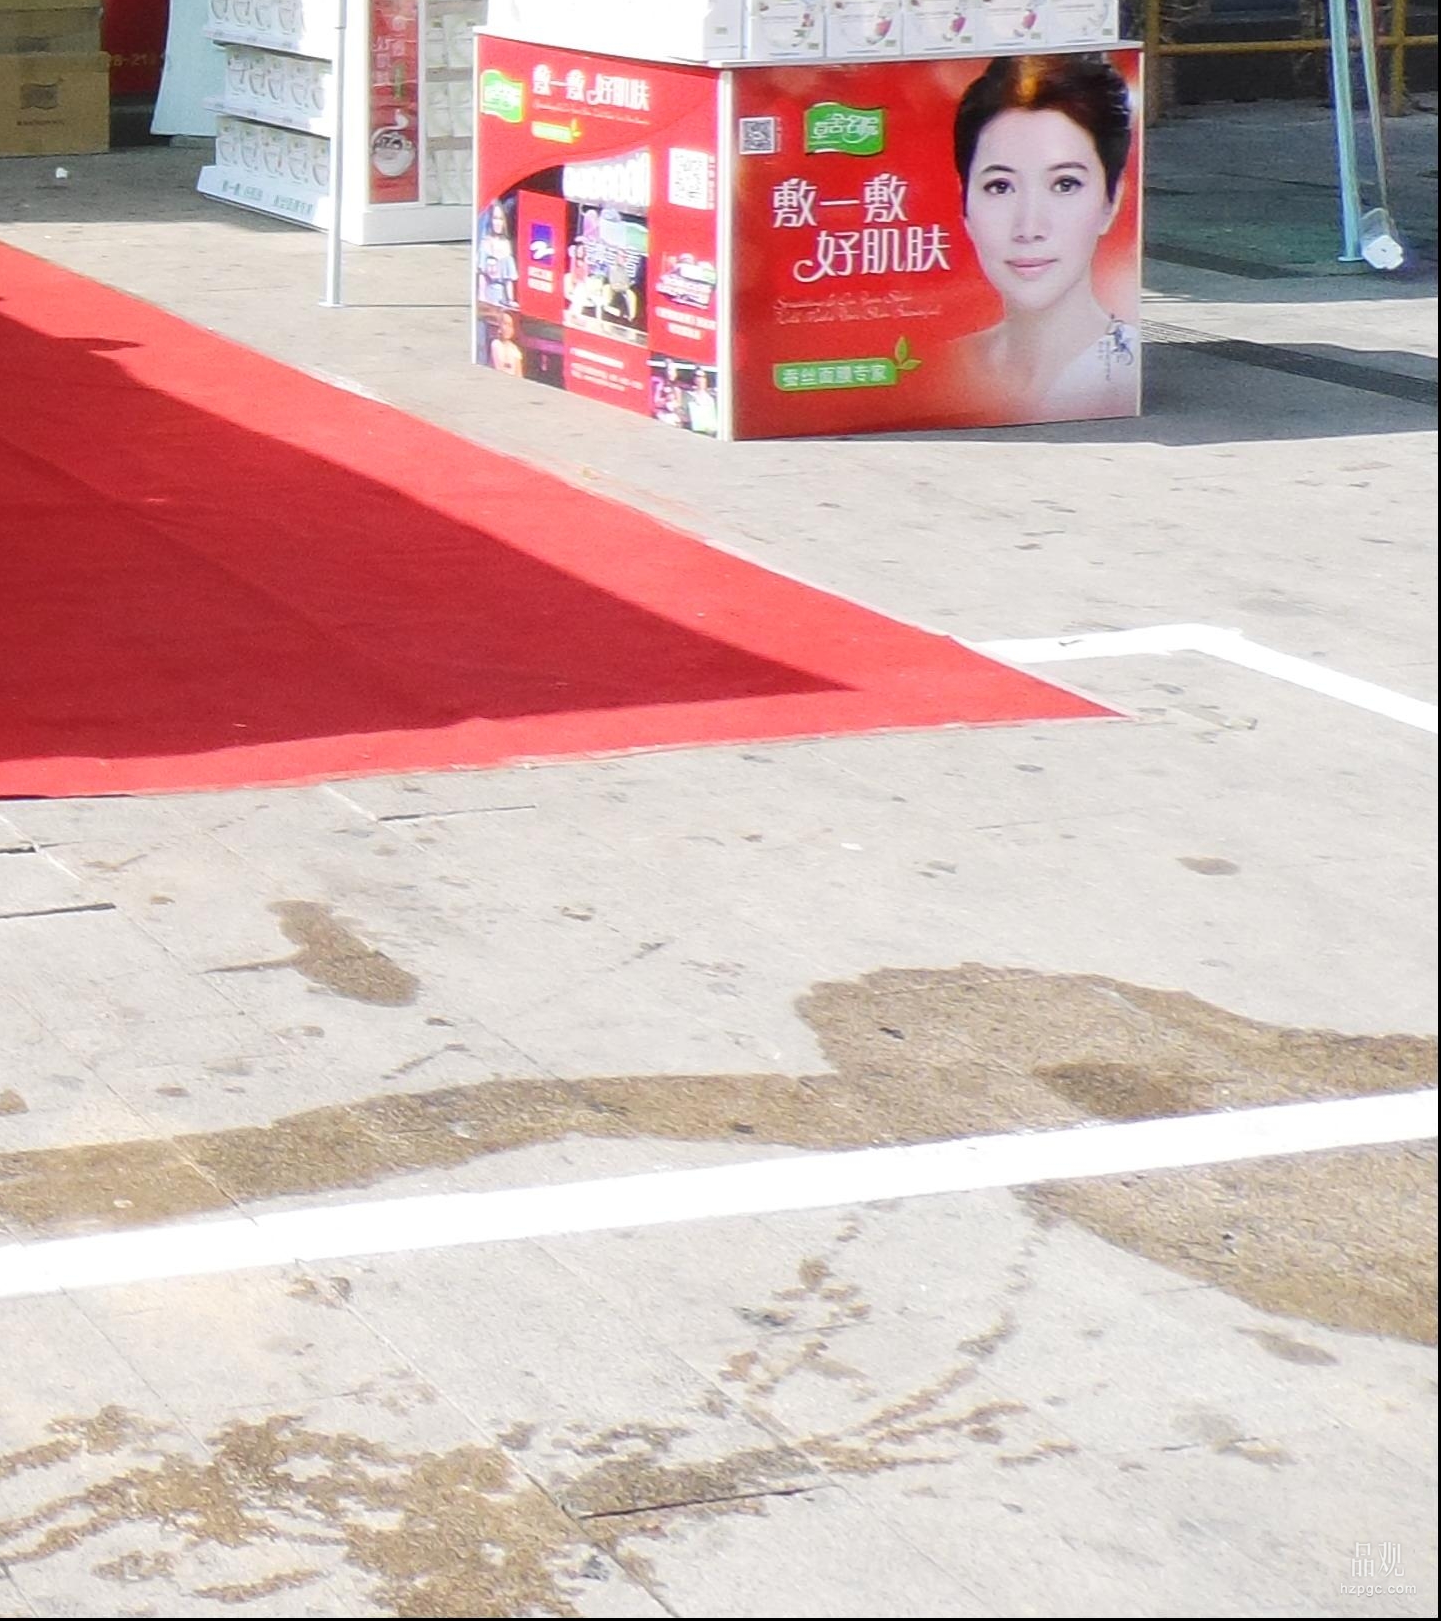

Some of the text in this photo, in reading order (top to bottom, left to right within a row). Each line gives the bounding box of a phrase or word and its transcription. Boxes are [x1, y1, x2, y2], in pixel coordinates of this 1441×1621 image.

[772, 173, 909, 228] 敷一敷
[792, 224, 952, 283] 好肌肤
[782, 364, 887, 388] 蚕丝面膜专家
